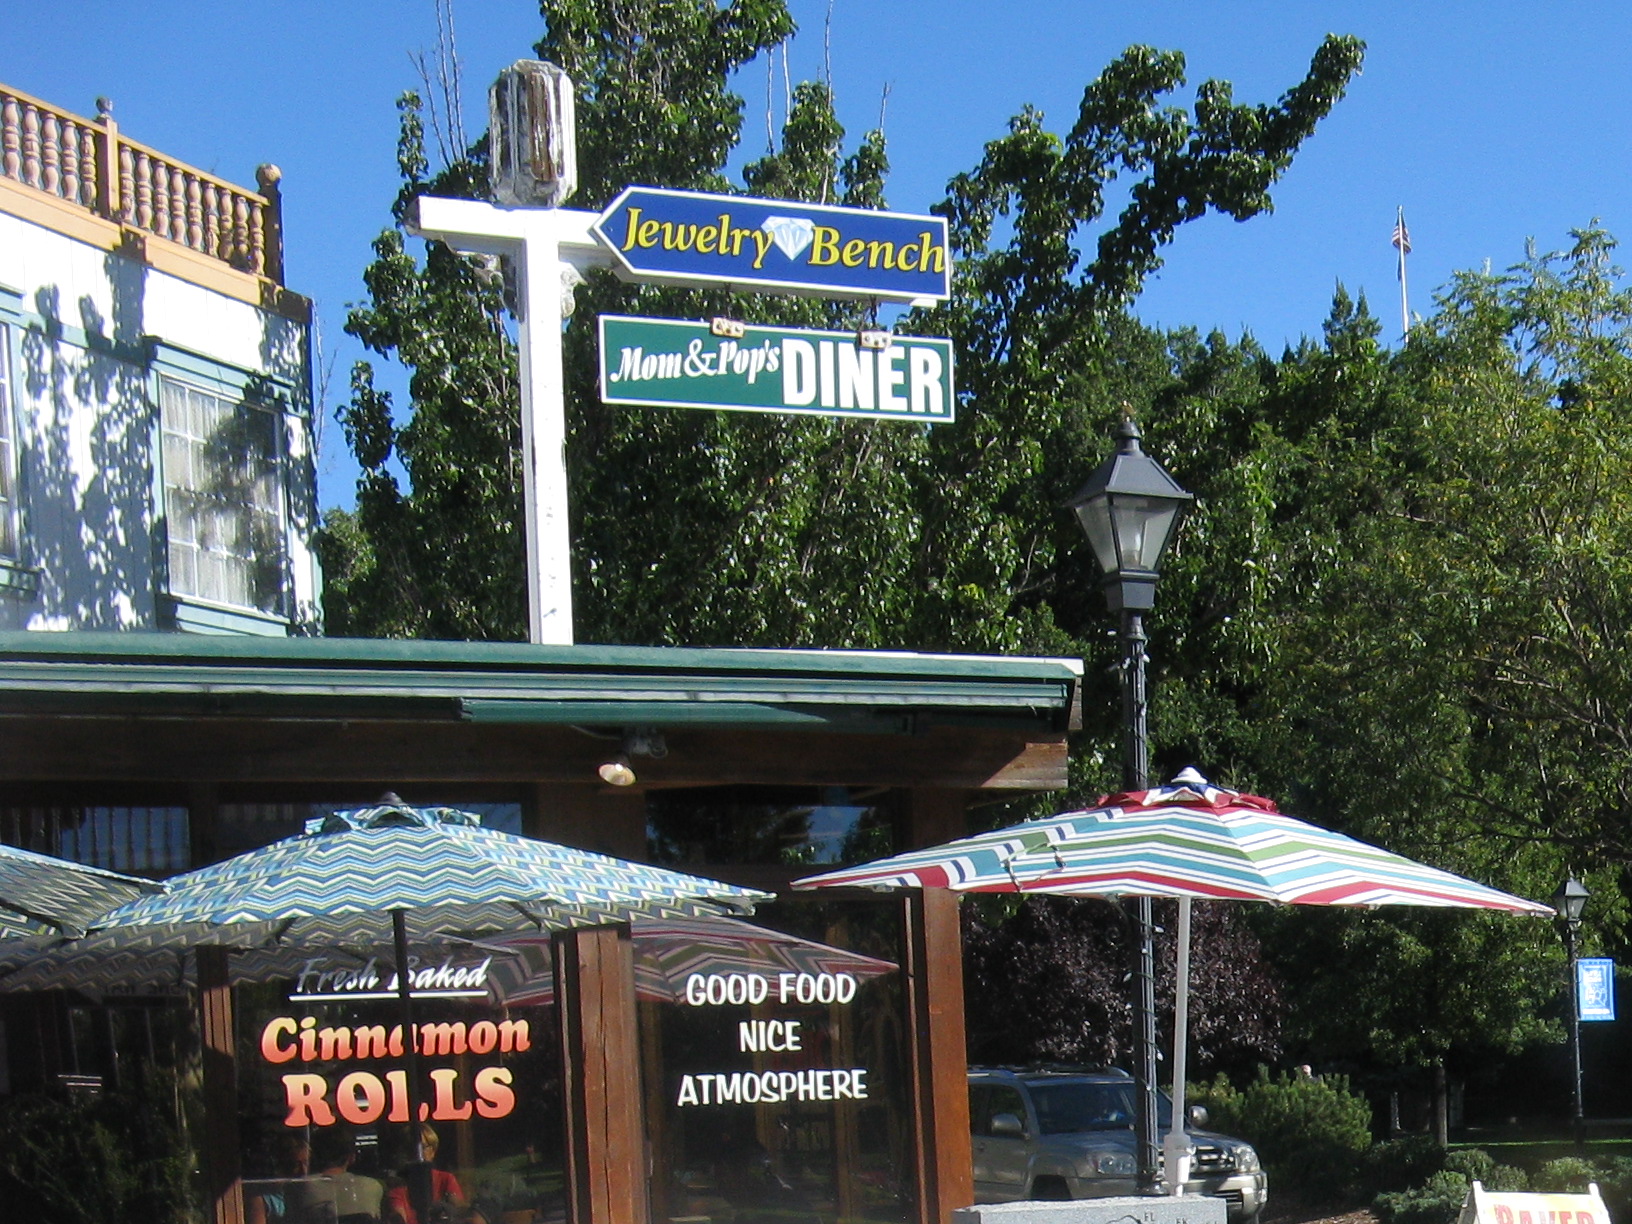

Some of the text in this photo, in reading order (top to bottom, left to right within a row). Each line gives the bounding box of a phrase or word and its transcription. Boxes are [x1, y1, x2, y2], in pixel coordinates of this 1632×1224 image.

[621, 207, 944, 273] Jewelry Bench
[782, 338, 944, 414] DINER
[296, 956, 380, 992] Fresh
[685, 973, 856, 1006] GOOD FOOD
[739, 1021, 802, 1052] NICE
[281, 1067, 515, 1127] ROLLS
[677, 1069, 868, 1106] ATMOSPHERE
